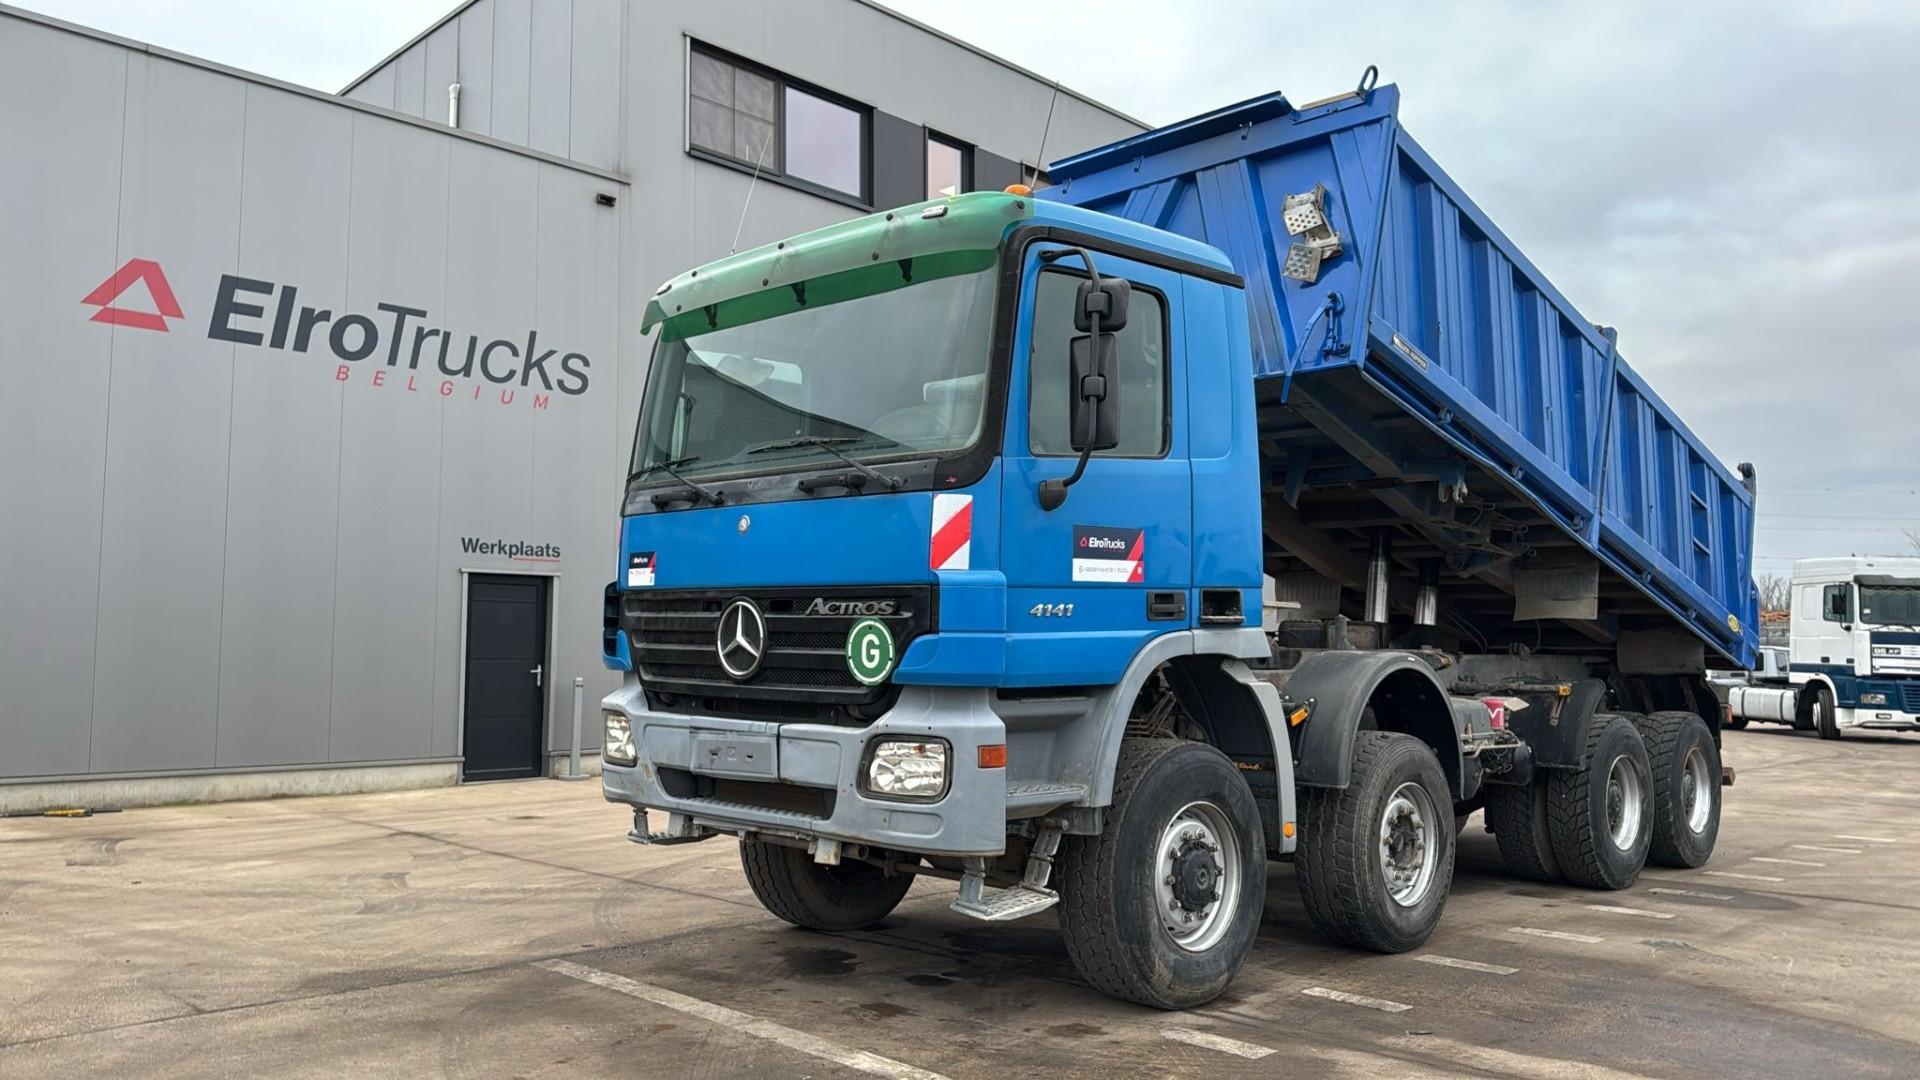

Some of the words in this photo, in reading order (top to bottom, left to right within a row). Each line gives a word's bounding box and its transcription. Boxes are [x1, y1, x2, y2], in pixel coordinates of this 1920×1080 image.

[207, 274, 590, 395] ElroTrucks
[336, 365, 549, 410] BELGIUM
[461, 537, 560, 559] Werkplaats
[1088, 536, 1125, 550] ElroTrucks
[1030, 603, 1074, 617] 4141
[861, 633, 880, 669] G
